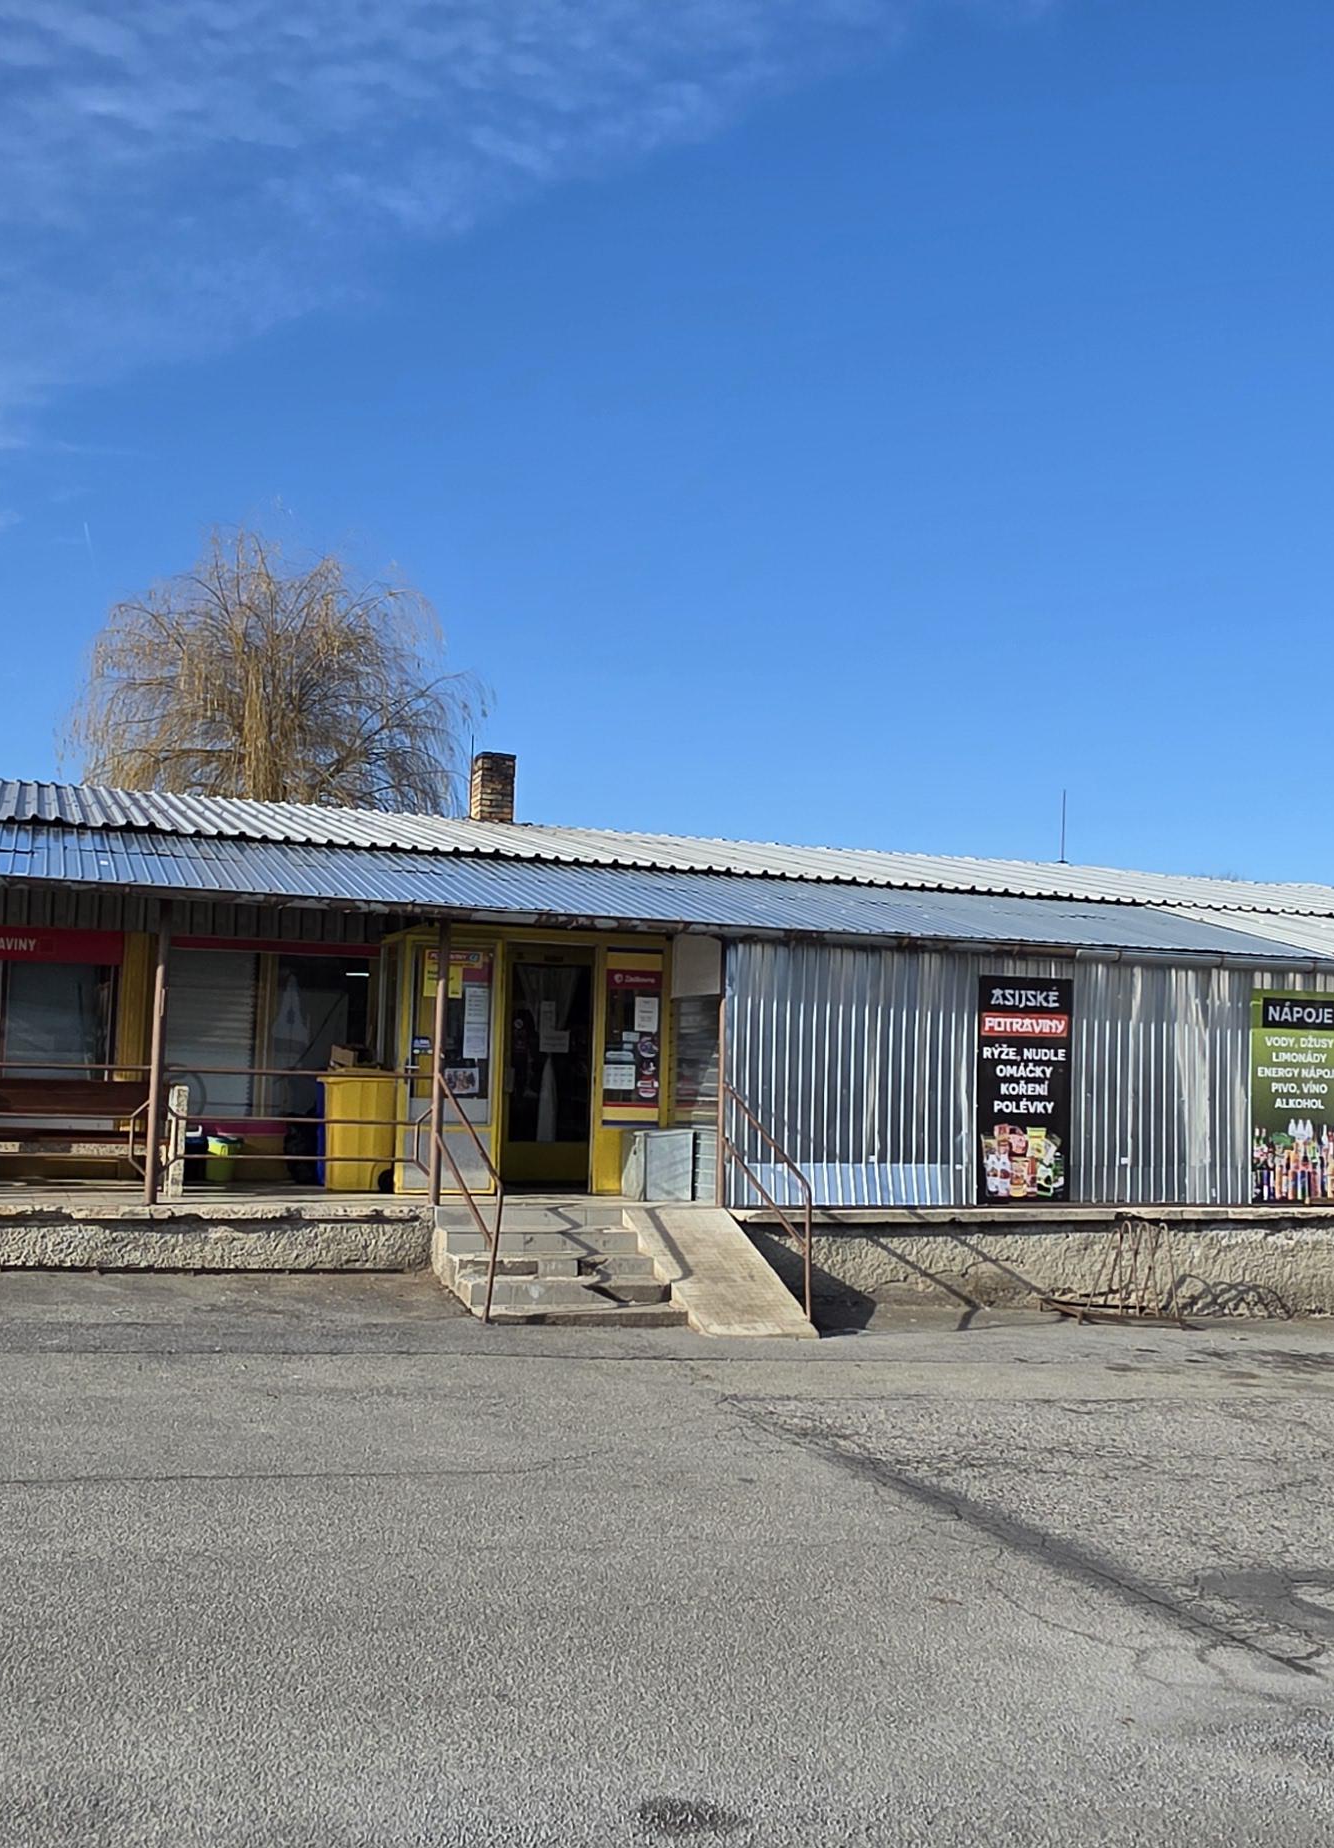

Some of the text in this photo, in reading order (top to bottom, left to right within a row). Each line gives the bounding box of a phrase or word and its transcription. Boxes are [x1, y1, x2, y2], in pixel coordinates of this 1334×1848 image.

[990, 986, 1060, 1008] ASIJSKÉ
[1268, 1001, 1334, 1024] NÁPOJE
[984, 1017, 1066, 1034] POTRAVINY
[1265, 1035, 1334, 1049] VODY, DŽUSY
[983, 1043, 1067, 1062] RÝŽE, NUDLE
[1272, 1050, 1327, 1063] LIMONÁDY
[996, 1062, 1053, 1078] OMÁČKY
[1257, 1066, 1299, 1078] ENERGY
[1000, 1080, 1049, 1096] KOŘENÍ
[1271, 1080, 1328, 1094] PIVO, VÍNO
[993, 1098, 1054, 1114] POLÉVKY
[1274, 1098, 1325, 1109] ALKOHOL
